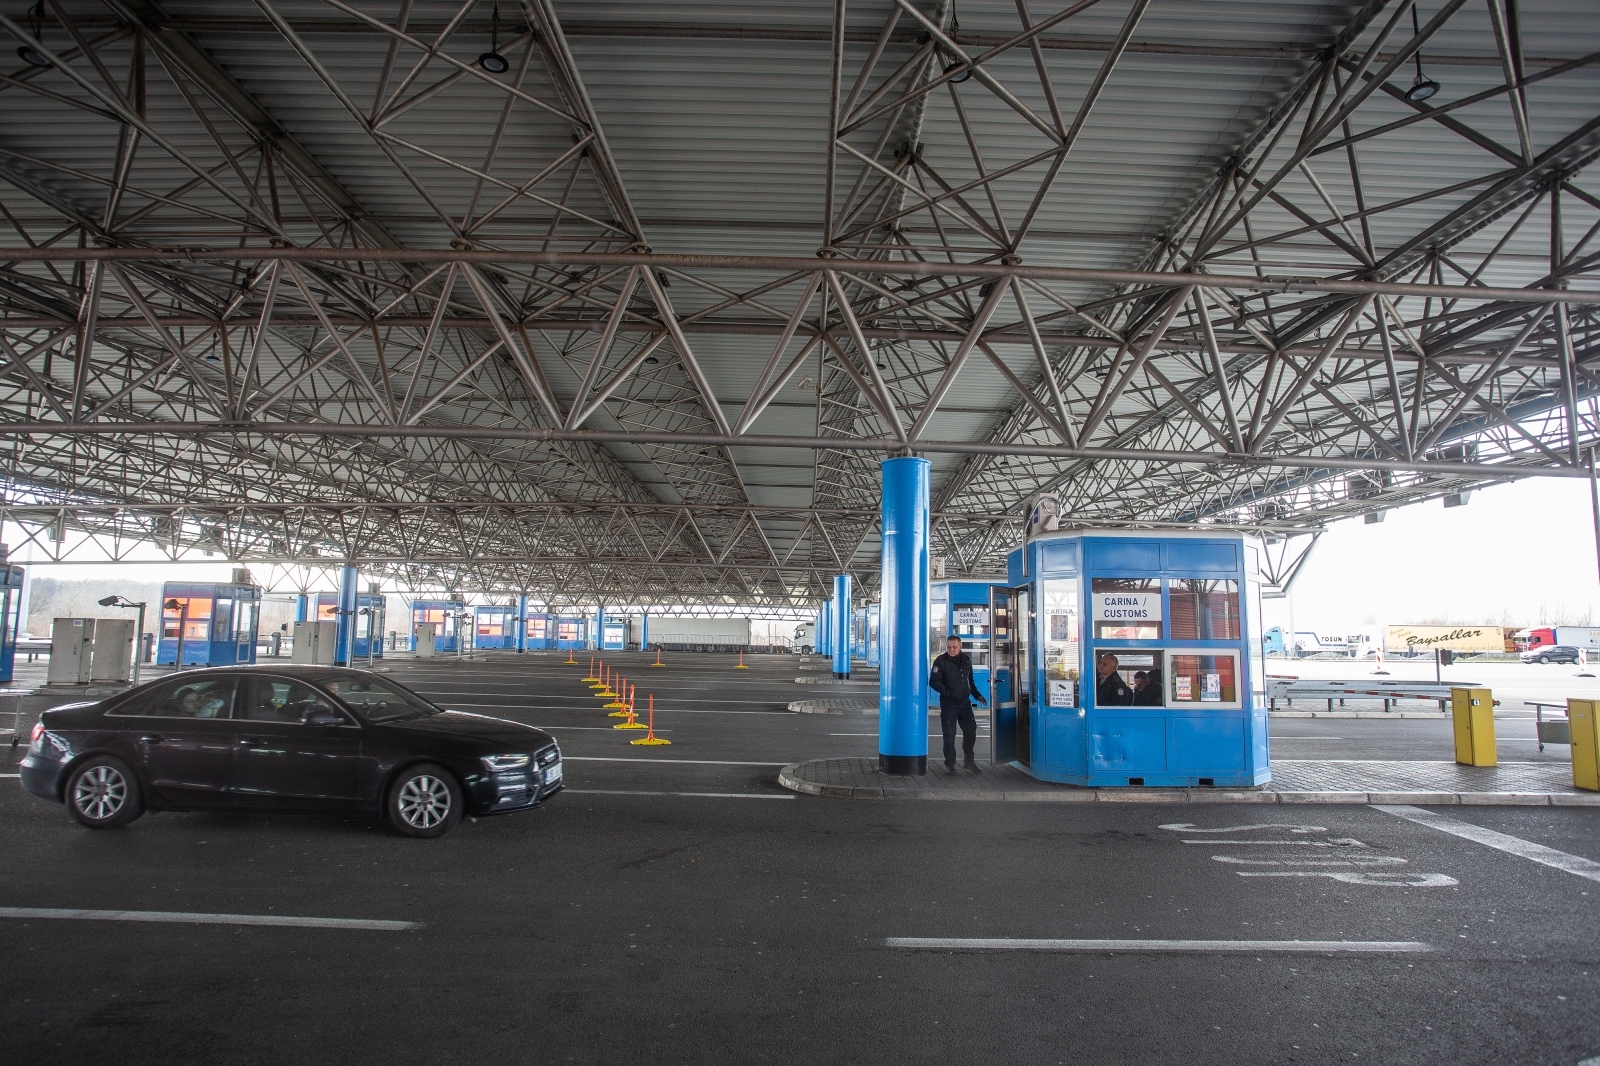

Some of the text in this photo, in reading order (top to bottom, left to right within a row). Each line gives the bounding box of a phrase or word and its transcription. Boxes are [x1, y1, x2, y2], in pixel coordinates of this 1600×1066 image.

[1104, 597, 1139, 606] CARINA
[1103, 609, 1148, 618] CUSTOMS
[1405, 628, 1483, 646] Baysallar
